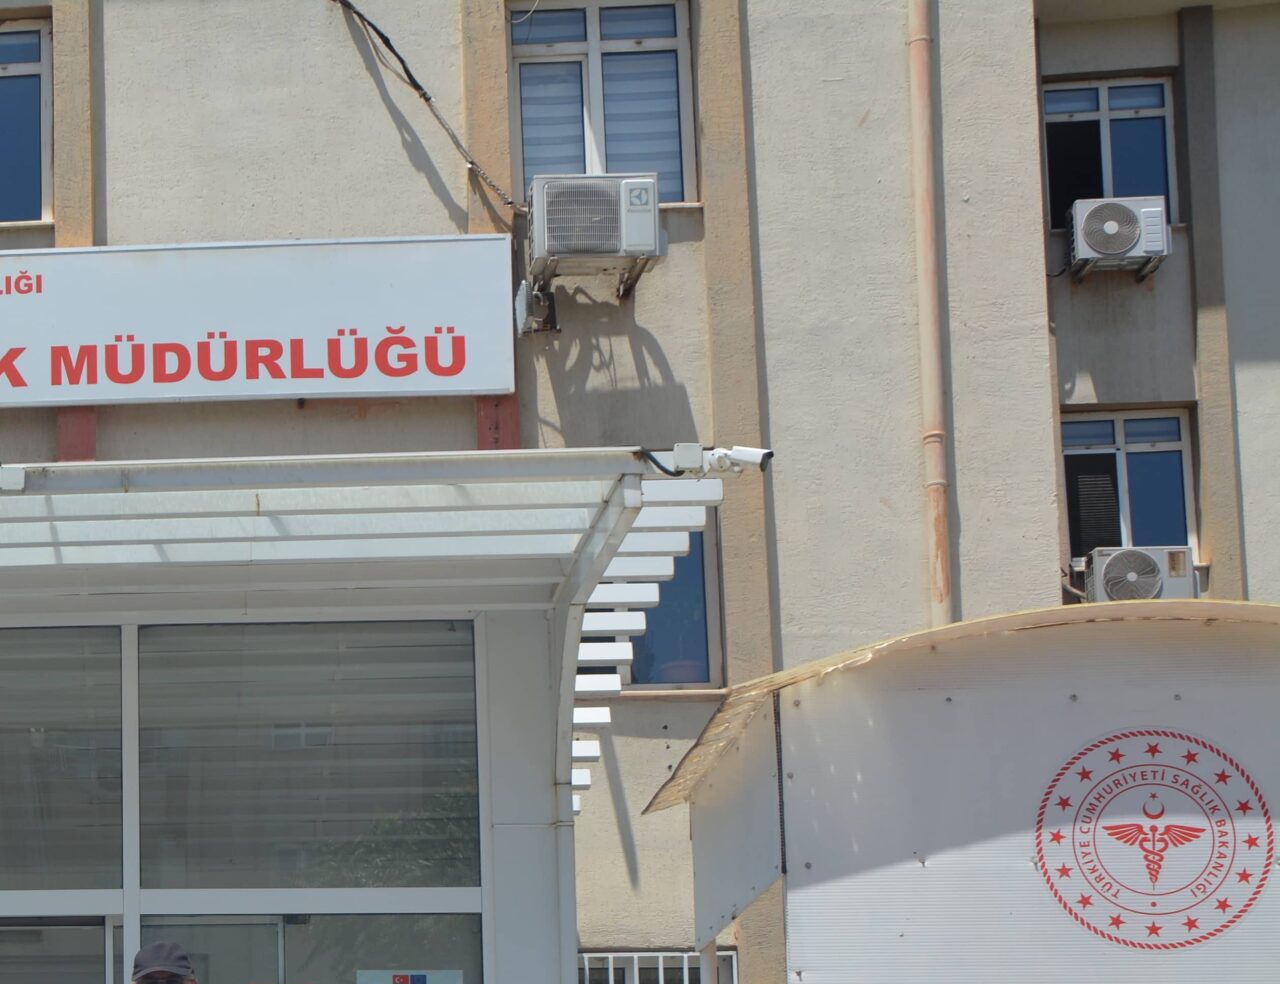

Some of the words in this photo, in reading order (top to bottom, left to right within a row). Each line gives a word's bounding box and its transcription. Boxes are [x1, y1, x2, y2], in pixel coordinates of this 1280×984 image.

[50, 325, 467, 386] MÜDÜRLÜĞÜ
[1079, 769, 1167, 835] CUMHURİYETİ
[1170, 773, 1222, 815] SAĞLIK
[1079, 840, 1121, 899] TÜRKİYE
[1190, 818, 1230, 899] BAKANLIĞI
